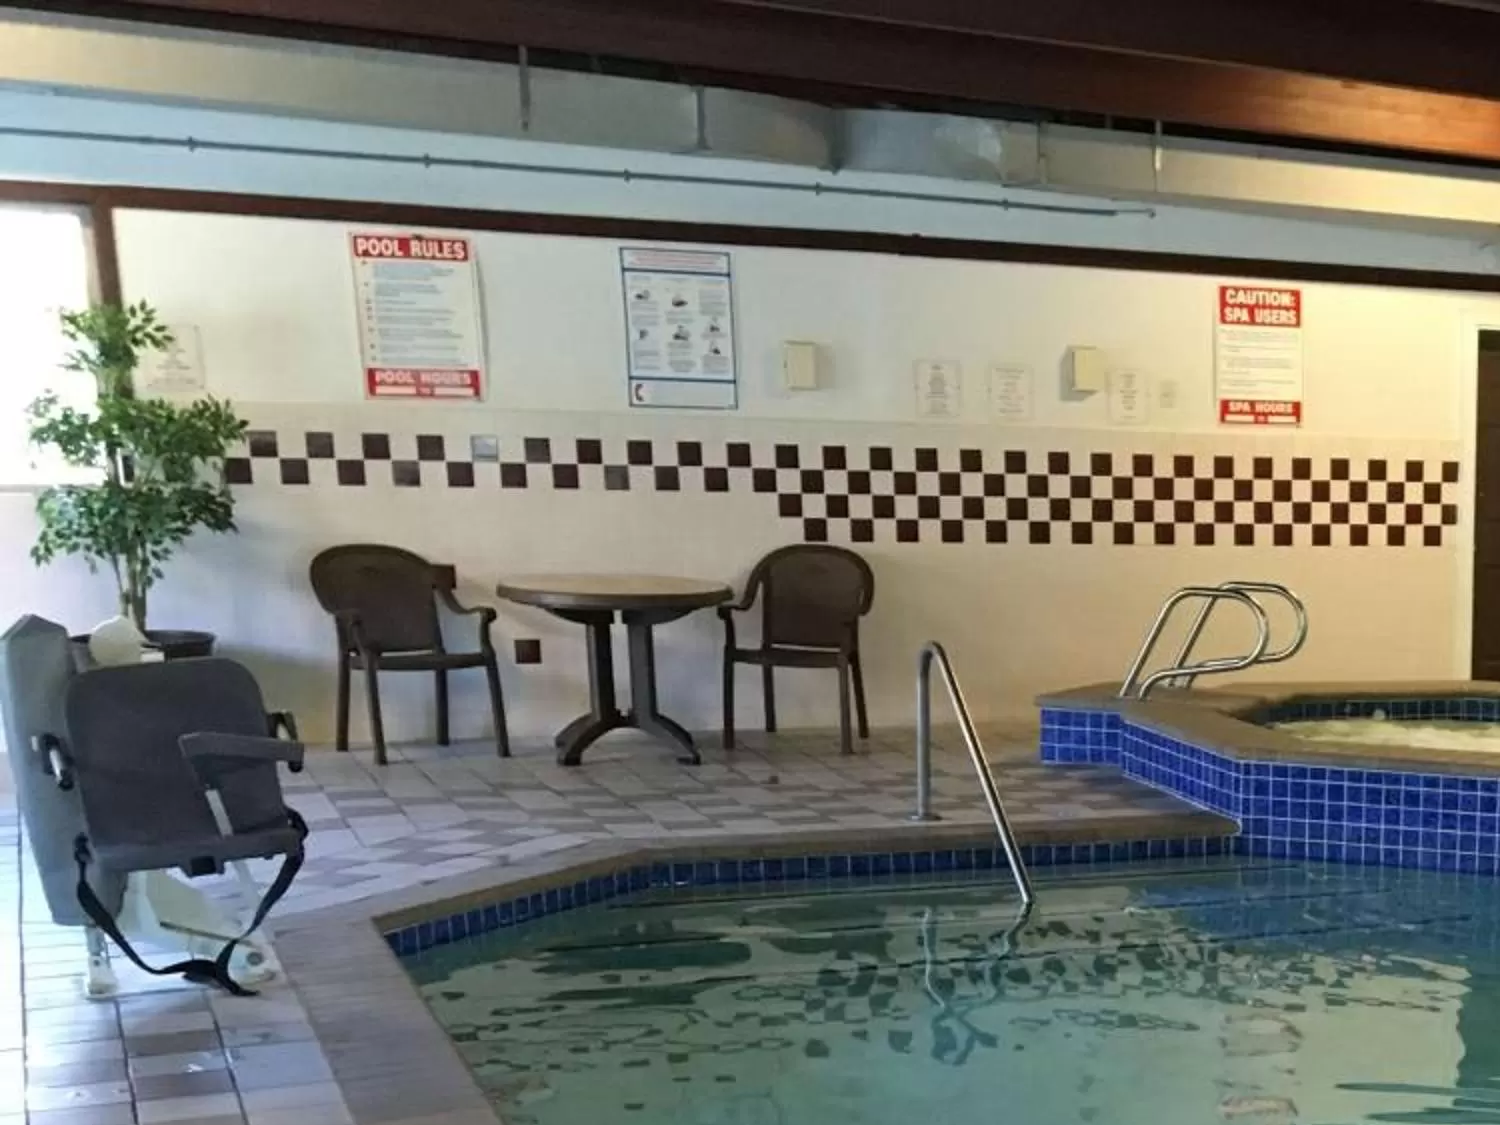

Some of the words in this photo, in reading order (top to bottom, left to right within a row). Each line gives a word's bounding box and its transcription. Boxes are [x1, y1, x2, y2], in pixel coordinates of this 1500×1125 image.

[356, 238, 404, 256] POOL
[410, 240, 465, 259] RULES
[1226, 288, 1296, 306] CAUTION:
[1224, 306, 1250, 322] SPA
[1254, 308, 1297, 325] USERS
[374, 371, 415, 385] POOL
